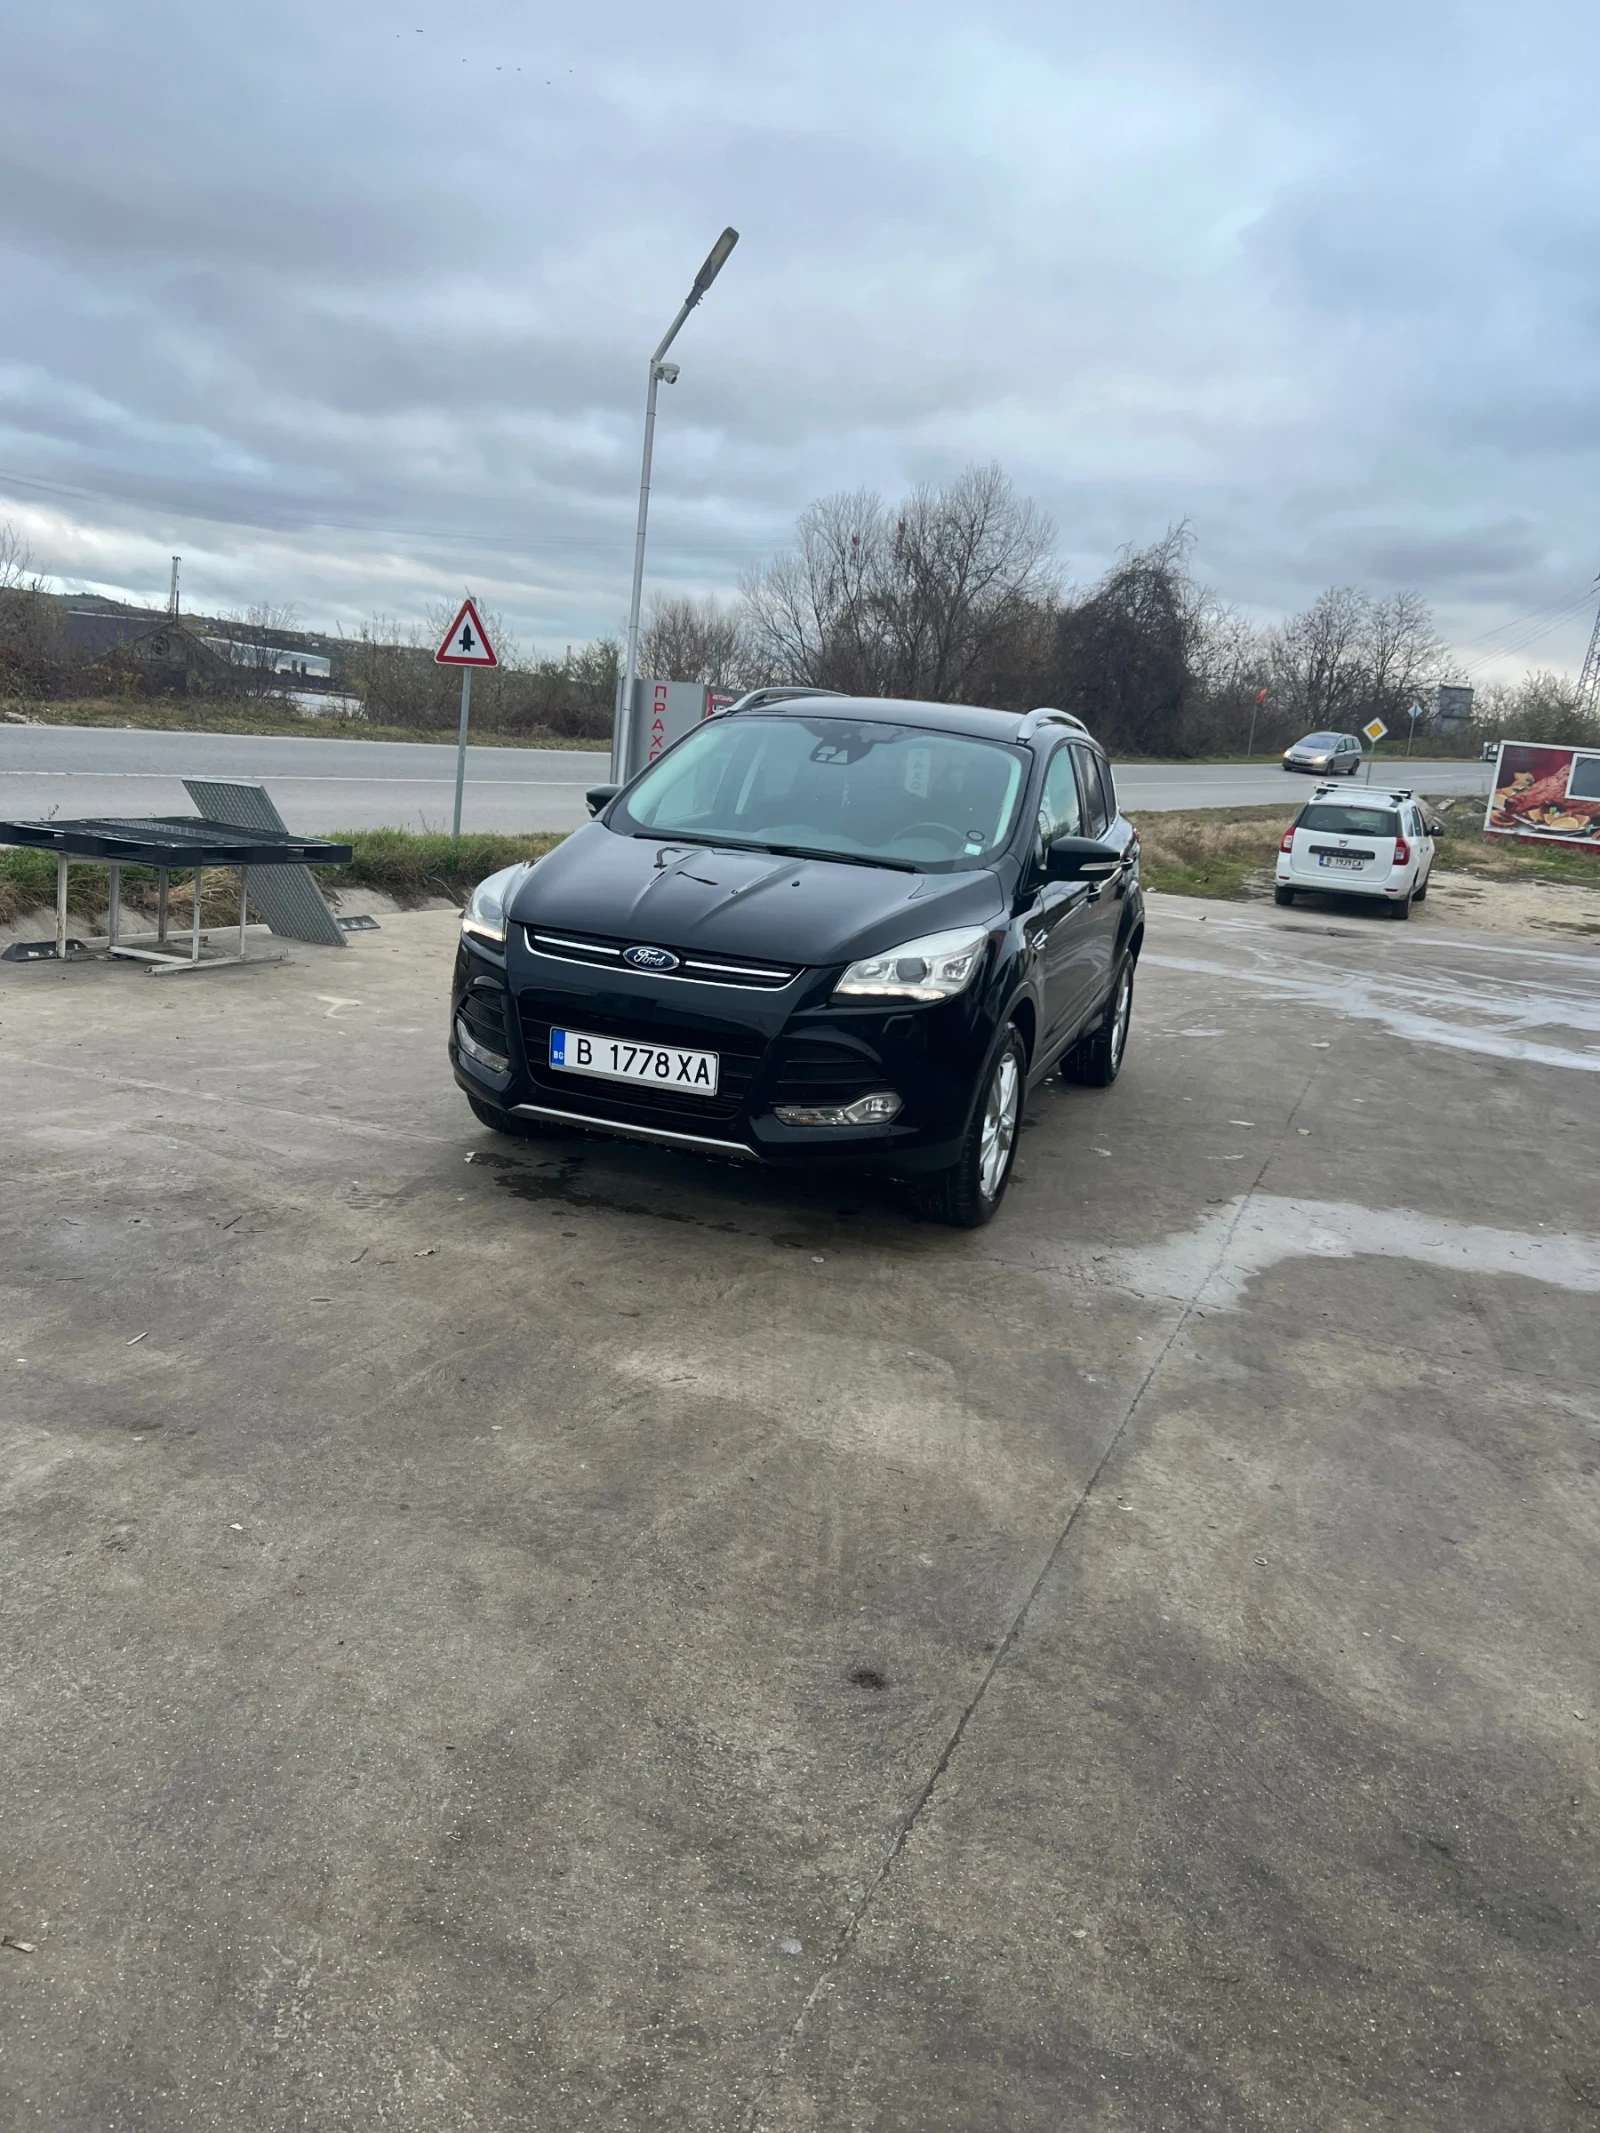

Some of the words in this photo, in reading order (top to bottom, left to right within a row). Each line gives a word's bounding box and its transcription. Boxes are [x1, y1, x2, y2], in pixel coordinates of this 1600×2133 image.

[633, 949, 666, 966] Ford
[553, 1050, 564, 1060] BG
[577, 1038, 593, 1065] B
[610, 1044, 670, 1078] 1778
[676, 1054, 710, 1085] XA
